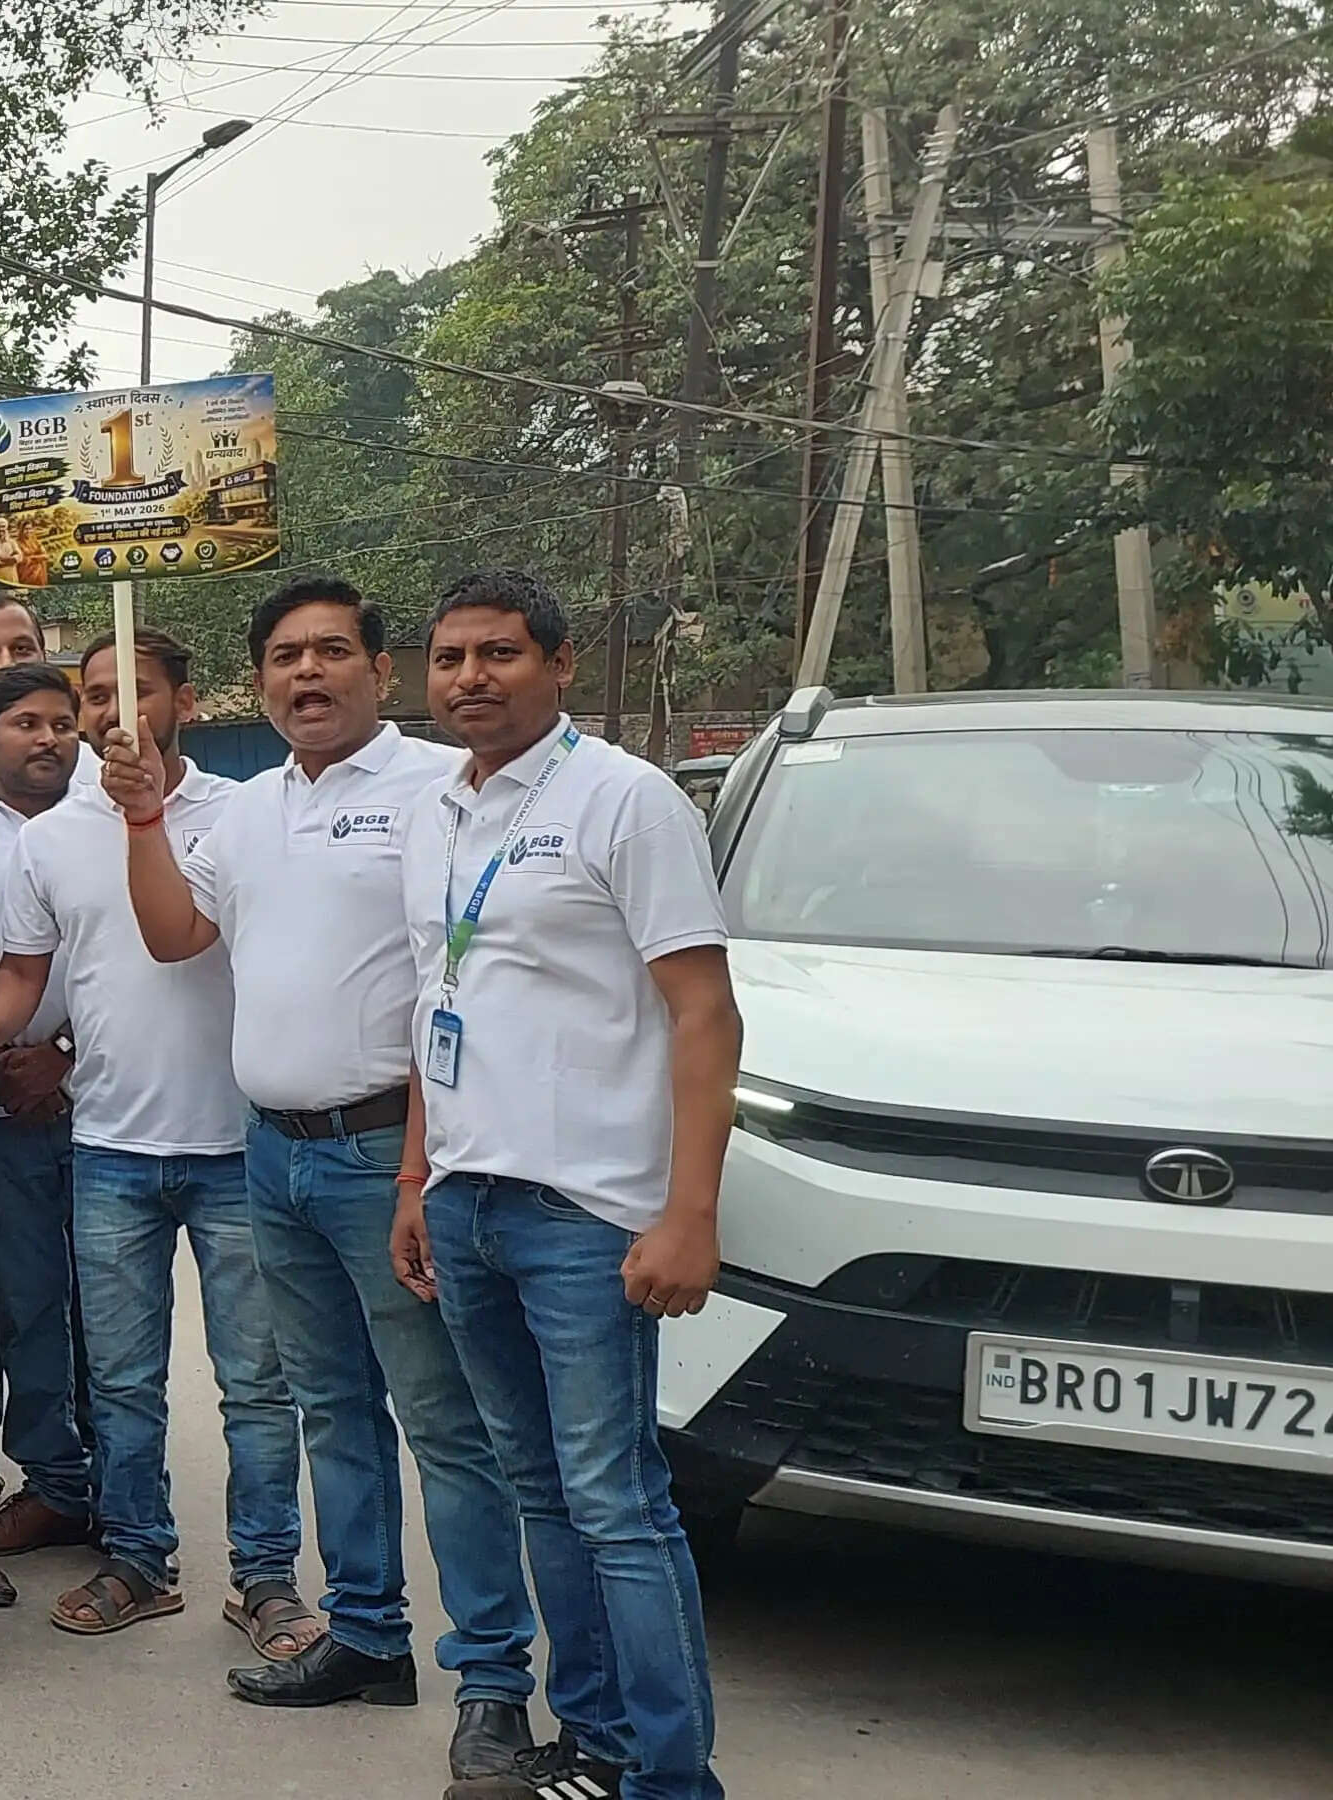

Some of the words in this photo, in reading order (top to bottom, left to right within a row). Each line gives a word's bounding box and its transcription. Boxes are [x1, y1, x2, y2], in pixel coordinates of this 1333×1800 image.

[84, 395, 126, 411] स्थापना
[130, 390, 161, 405] दिवस
[18, 415, 67, 439] BGB
[89, 487, 149, 502] FOUNDATION
[151, 485, 171, 499] DAY
[114, 505, 137, 516] MAY
[139, 503, 166, 514] 2026
[533, 757, 559, 788] BIHAR
[352, 815, 390, 826] BGB
[530, 834, 564, 849] BGB
[986, 1373, 1016, 1389] IND
[1019, 1357, 1333, 1438] BR01JW72
